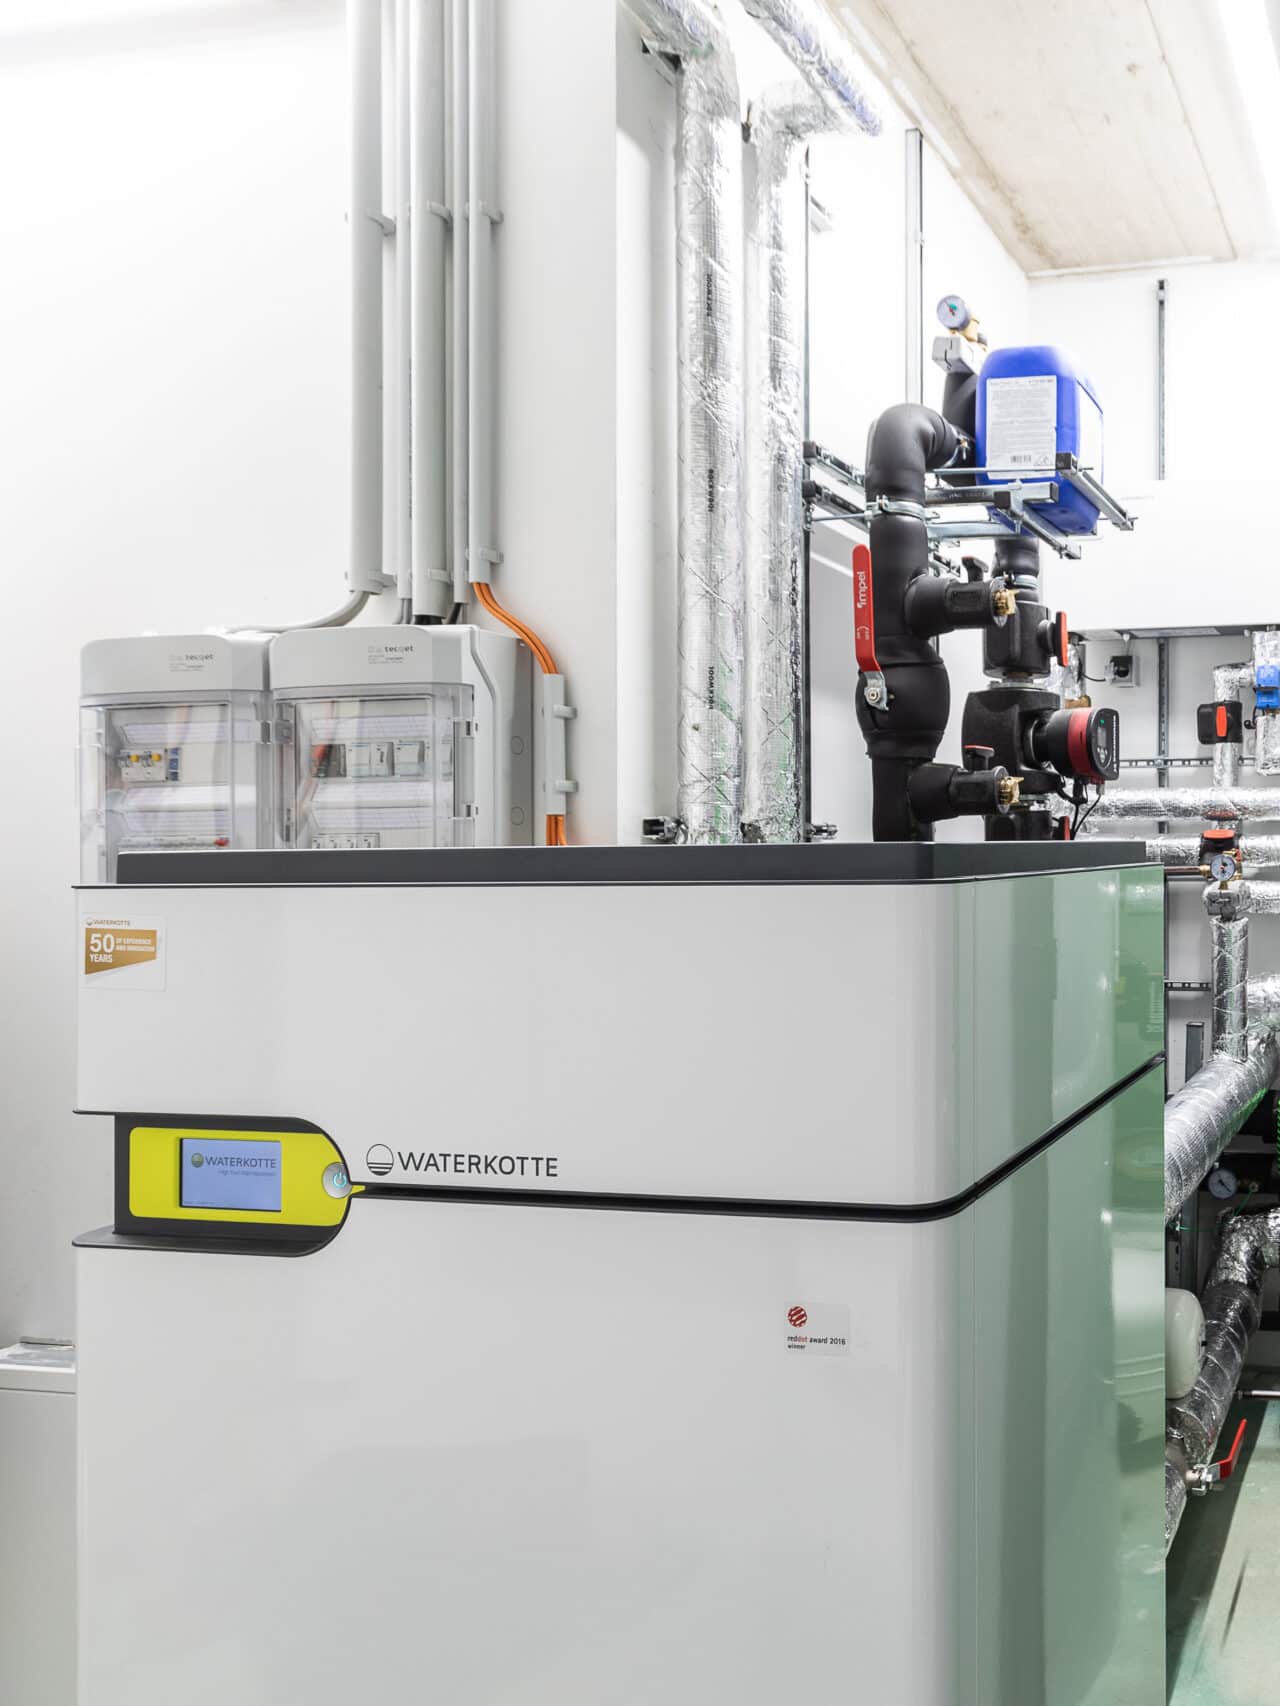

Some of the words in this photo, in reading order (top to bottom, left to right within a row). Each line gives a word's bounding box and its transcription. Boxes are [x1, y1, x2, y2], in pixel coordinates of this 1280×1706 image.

[90, 933, 115, 953] 50
[90, 953, 113, 963] YEARS
[205, 1156, 277, 1169] WATERKOTTE
[398, 1152, 559, 1178] WATERKOTTE
